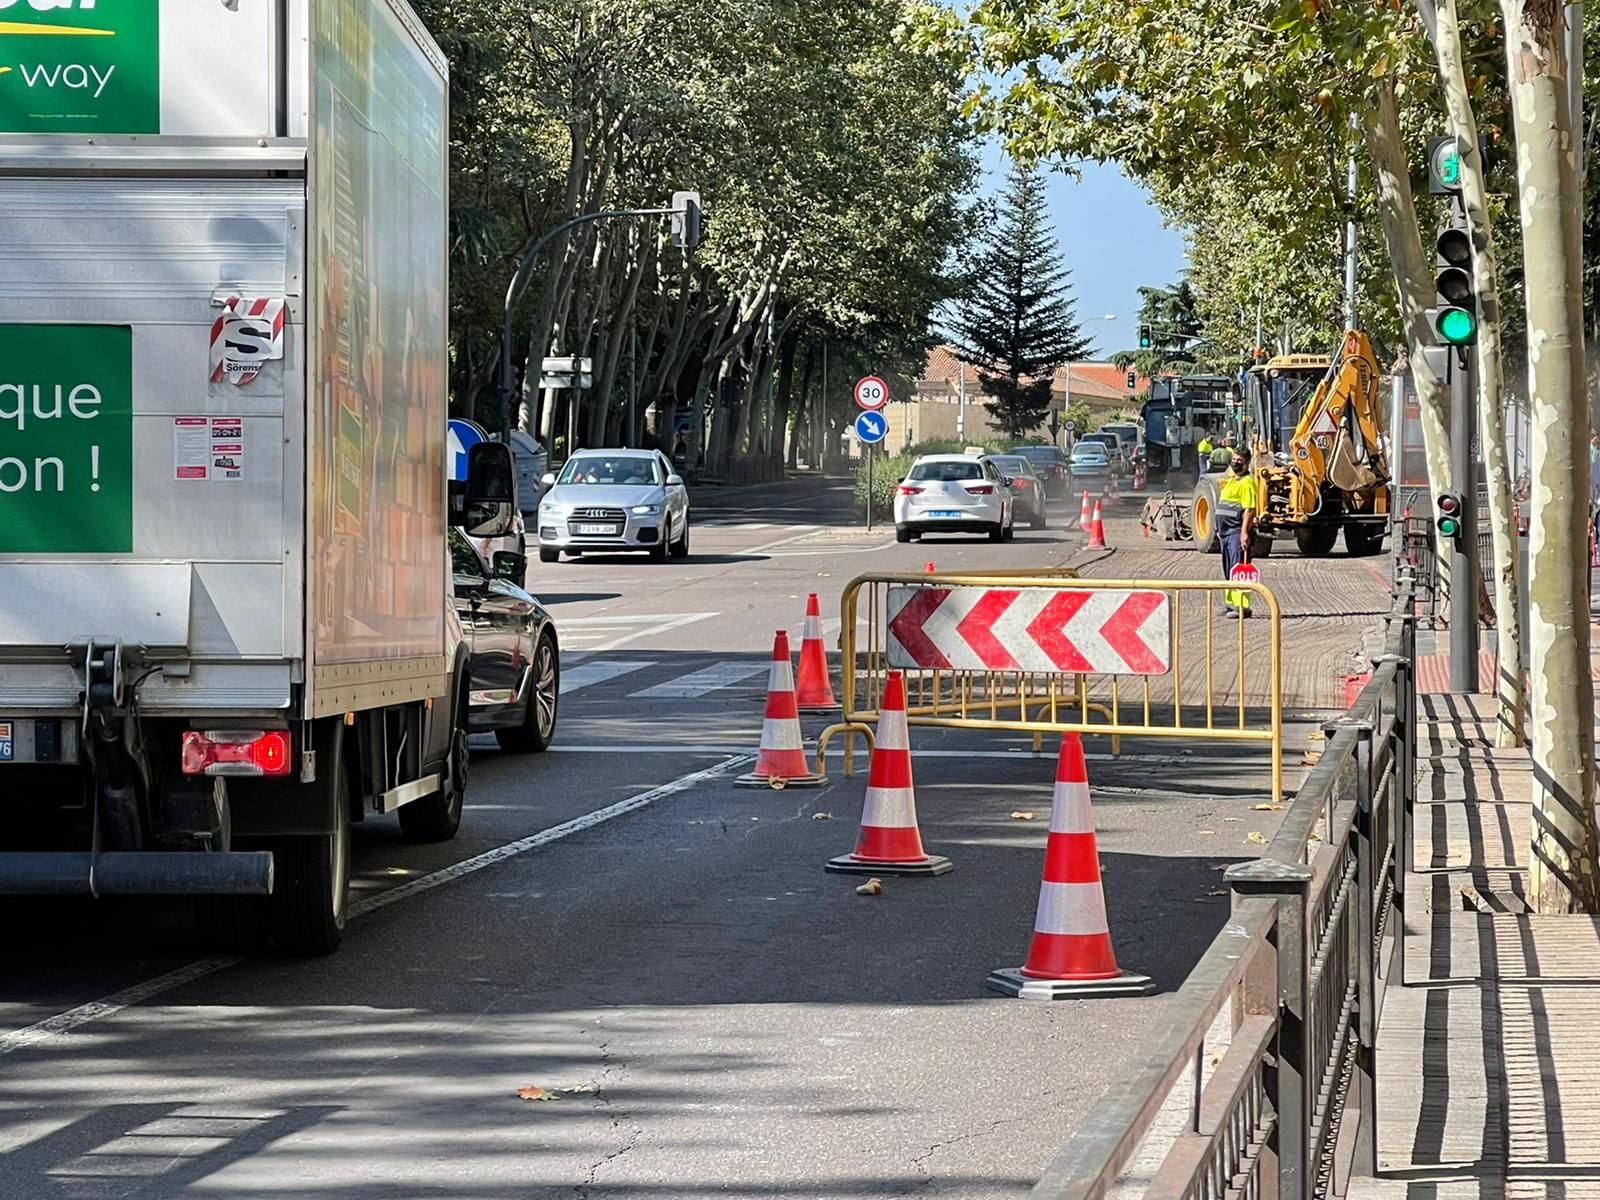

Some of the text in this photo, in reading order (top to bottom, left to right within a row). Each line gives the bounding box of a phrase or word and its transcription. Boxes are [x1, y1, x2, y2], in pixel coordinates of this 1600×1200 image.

[19, 63, 115, 98] way
[0, 383, 102, 431] que
[862, 387, 881, 399] 30
[90, 445, 100, 492] !
[1232, 571, 1258, 582] STOP
